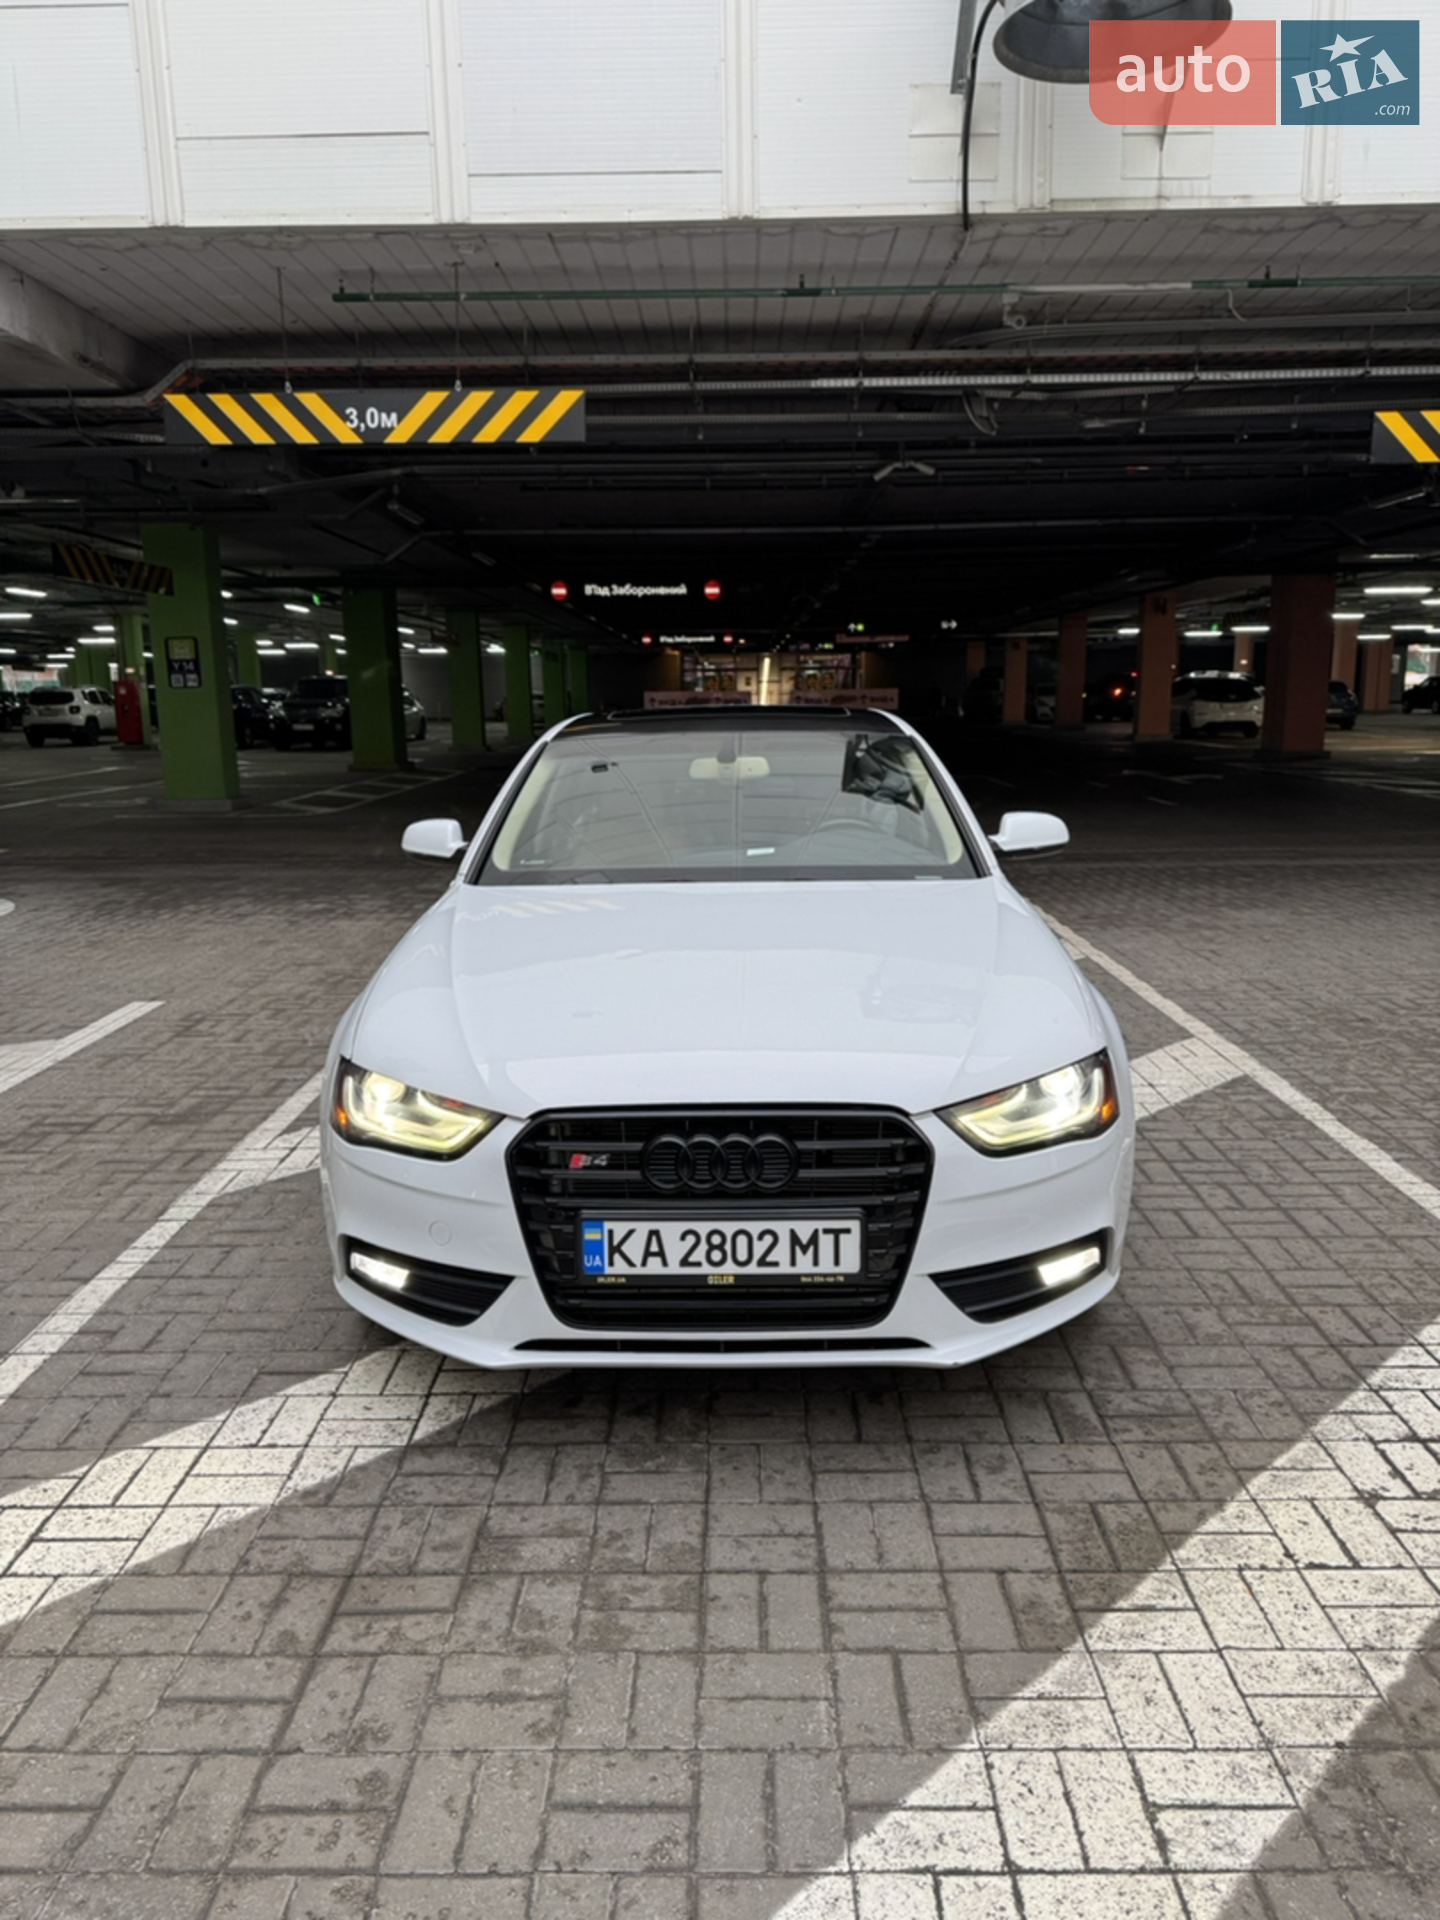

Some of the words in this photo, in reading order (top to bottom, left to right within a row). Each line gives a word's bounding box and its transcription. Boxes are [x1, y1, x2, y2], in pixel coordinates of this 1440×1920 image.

[584, 1254, 603, 1267] UA
[608, 1228, 669, 1268] KA
[679, 1228, 780, 1268] 2802
[789, 1228, 852, 1268] MT
